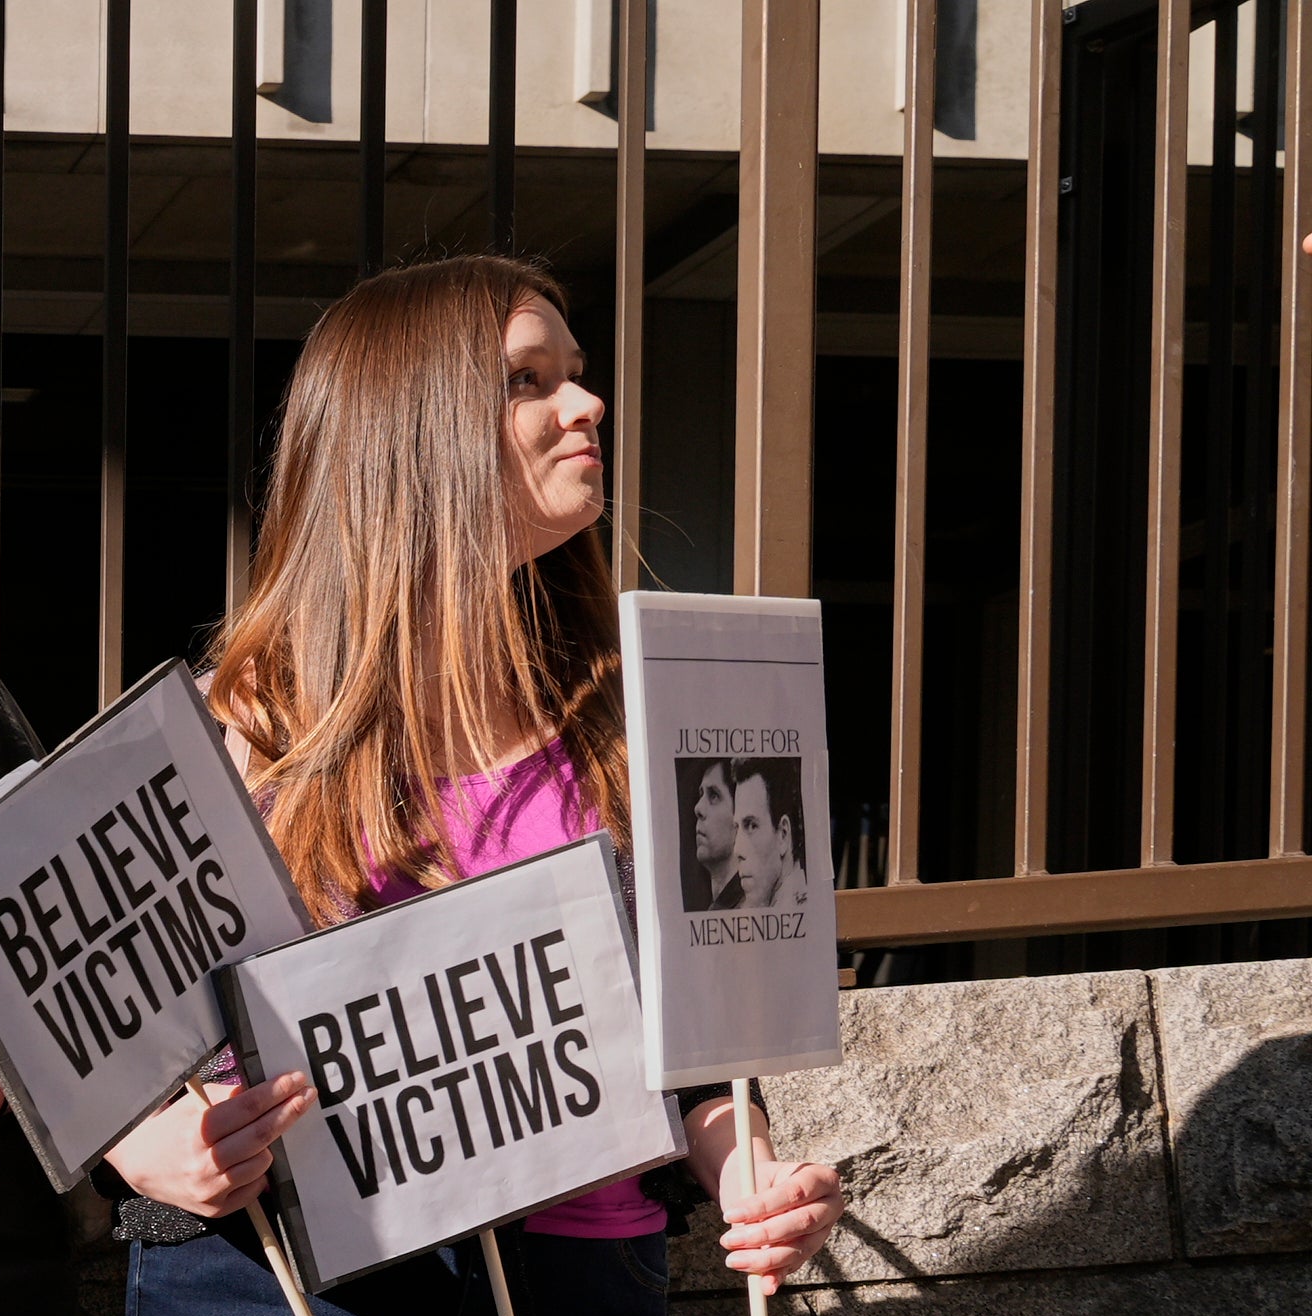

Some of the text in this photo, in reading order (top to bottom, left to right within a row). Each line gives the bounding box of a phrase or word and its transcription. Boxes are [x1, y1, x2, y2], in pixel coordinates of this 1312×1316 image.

[676, 729, 800, 754] JUSTICE FOR
[33, 860, 247, 1079] VICTIMS
[689, 913, 806, 947] MENENDEZ
[298, 929, 584, 1108] BELIEVE
[327, 1029, 601, 1198] VICTIMS
